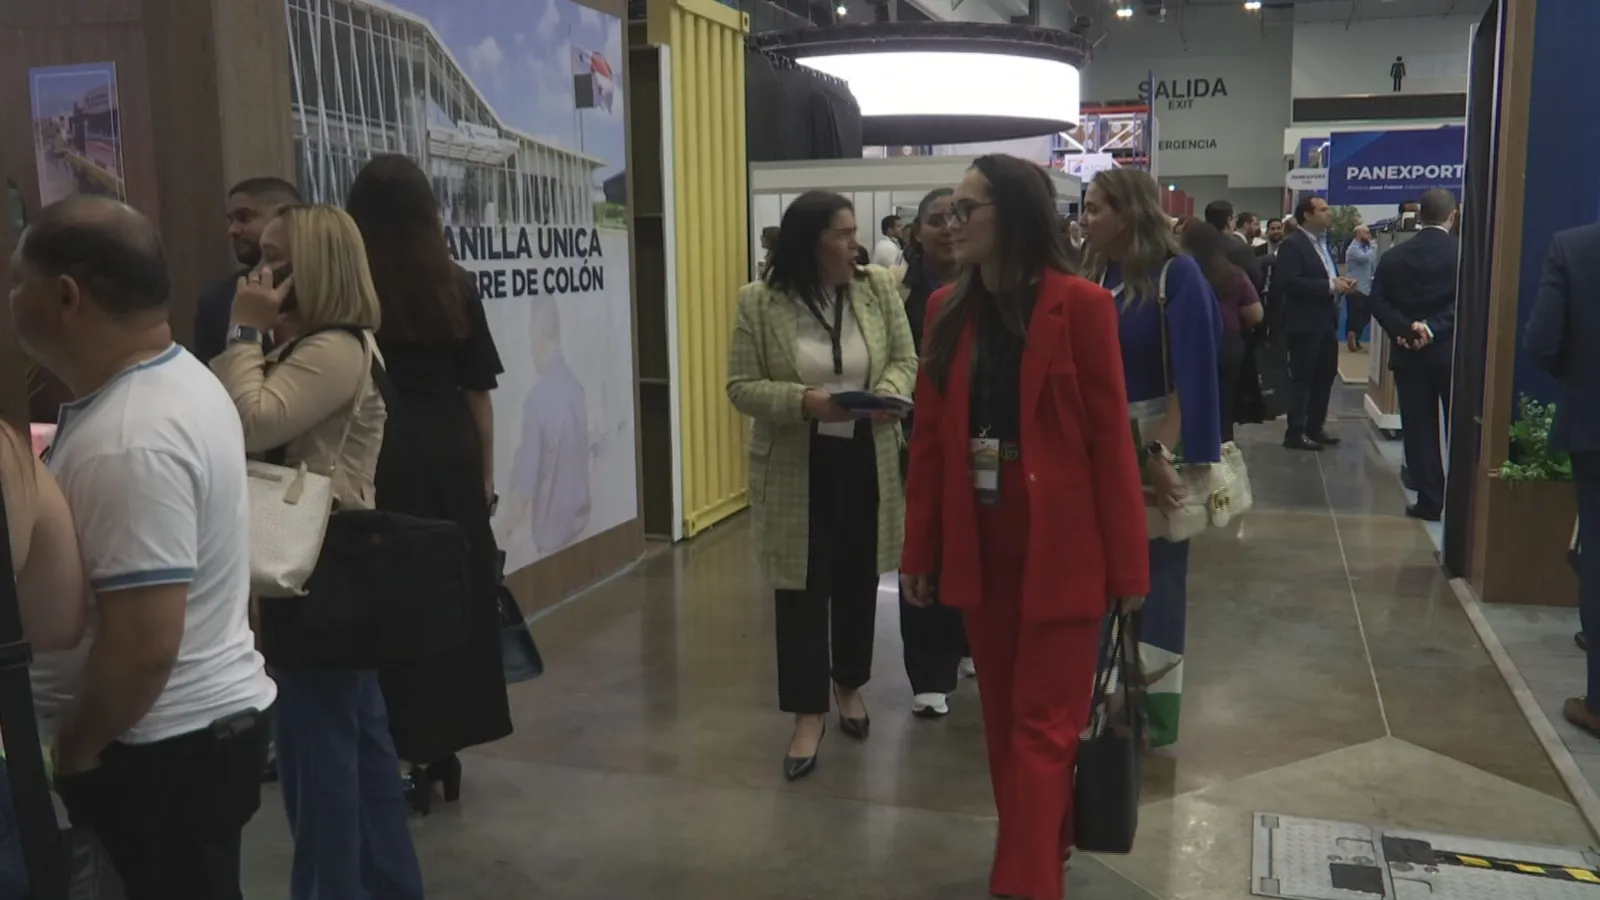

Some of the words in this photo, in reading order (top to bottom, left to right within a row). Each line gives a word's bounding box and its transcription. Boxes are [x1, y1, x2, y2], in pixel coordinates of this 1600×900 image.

[1138, 76, 1228, 103] SALIDA
[1168, 99, 1194, 111] EXIT
[512, 268, 539, 297] DE
[543, 259, 604, 295] COLÓN
